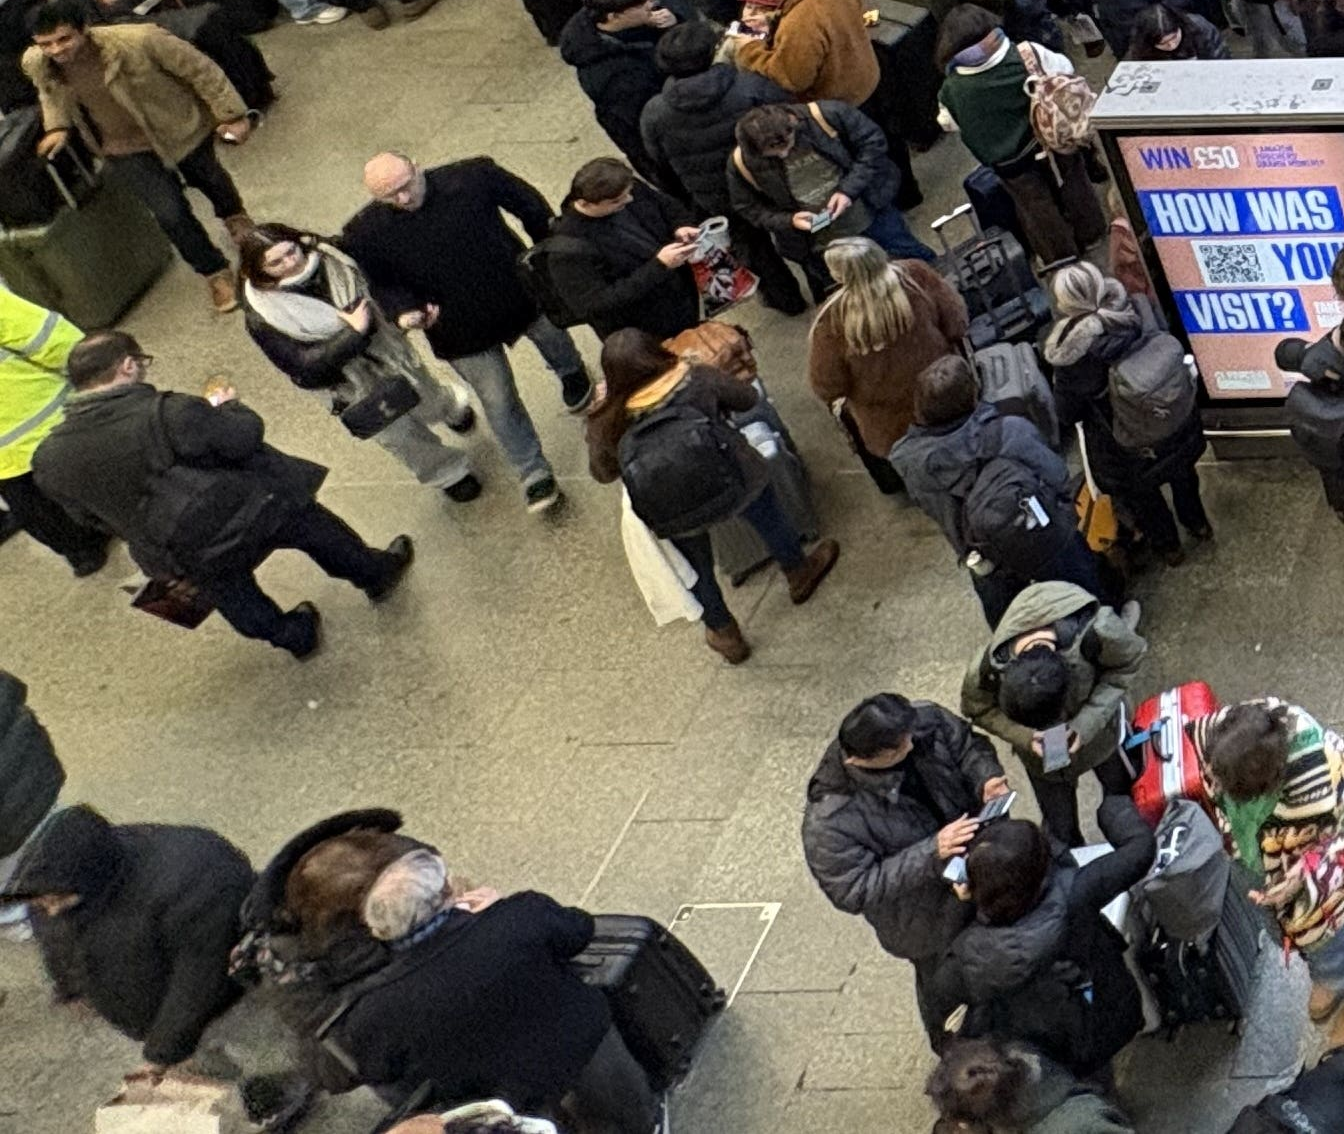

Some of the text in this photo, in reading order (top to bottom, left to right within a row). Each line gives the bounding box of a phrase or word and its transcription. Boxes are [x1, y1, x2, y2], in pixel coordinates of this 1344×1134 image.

[1139, 146, 1192, 171] WIN
[1193, 145, 1240, 169] £50
[1150, 190, 1334, 234] HOW WAS
[1185, 291, 1296, 331] VISIT?
